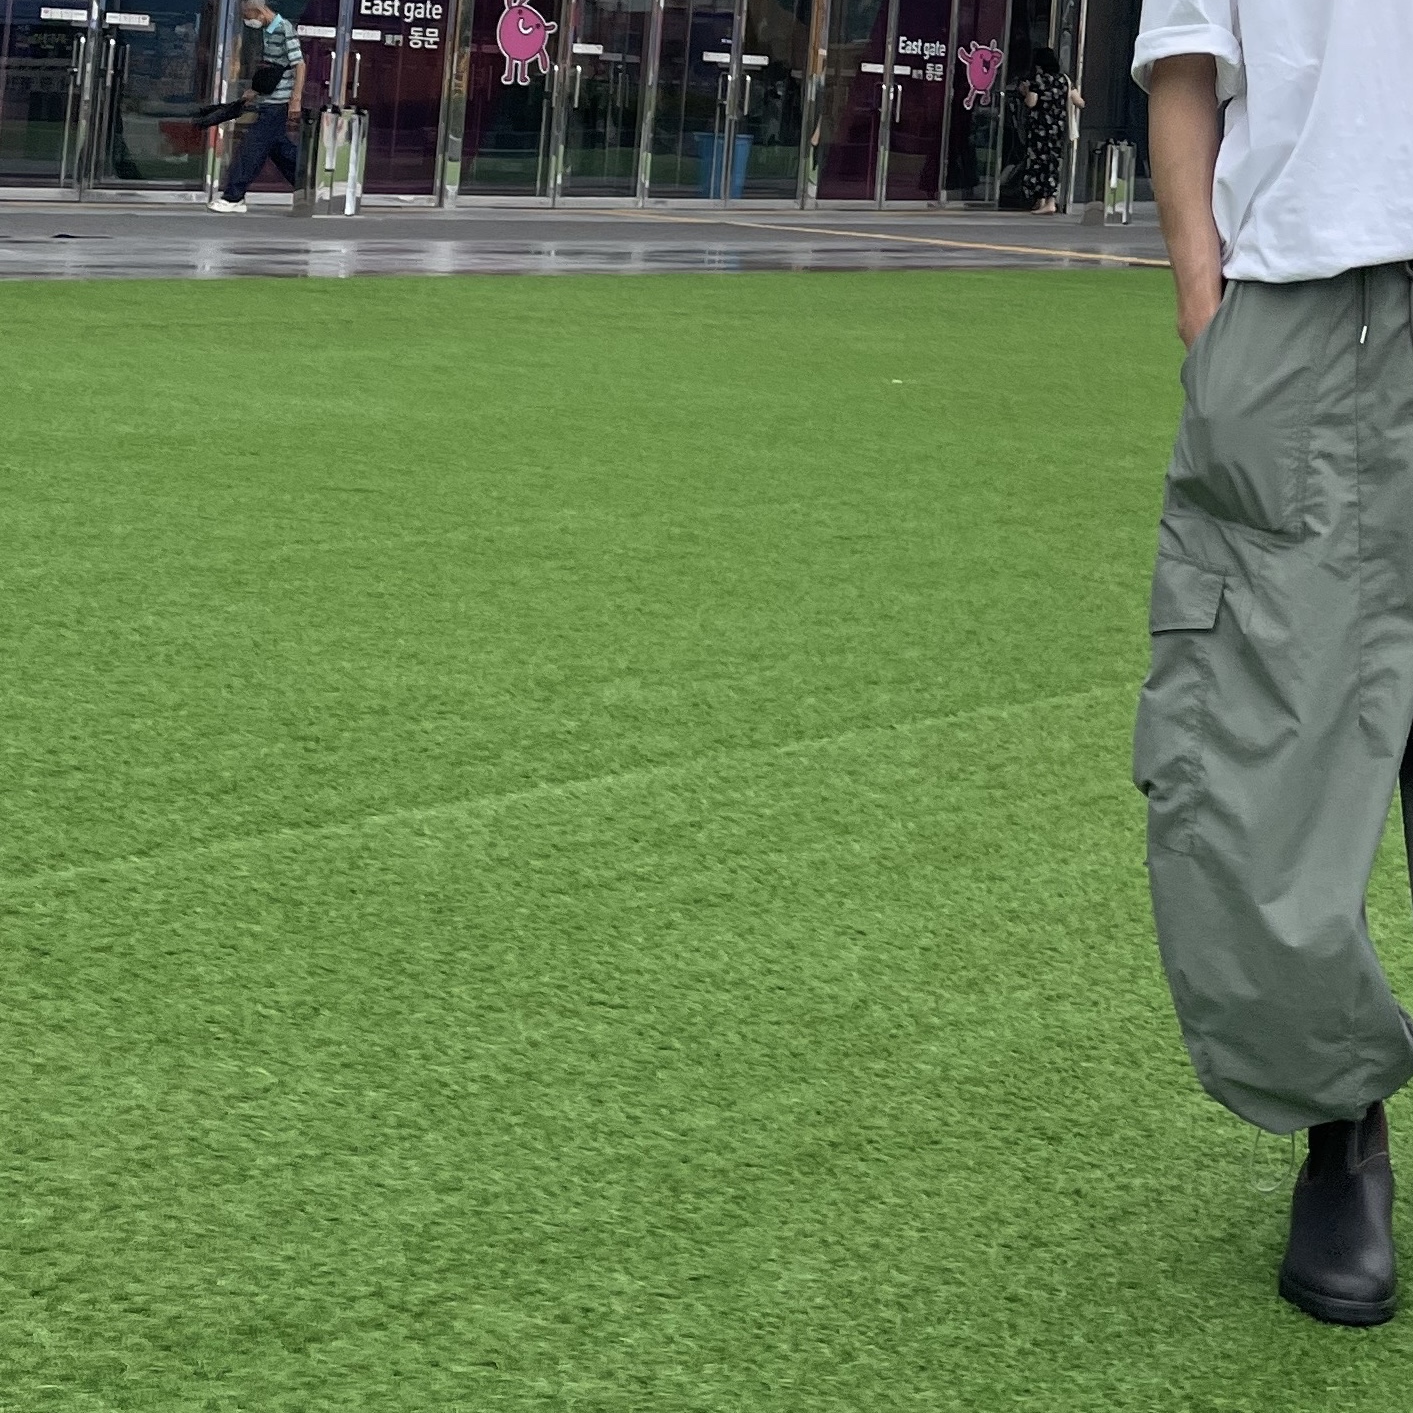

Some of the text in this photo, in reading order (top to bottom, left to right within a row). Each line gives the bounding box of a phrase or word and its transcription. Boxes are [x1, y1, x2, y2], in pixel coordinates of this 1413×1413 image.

[404, 0, 443, 23] gate
[408, 26, 439, 49] 동문
[899, 36, 946, 60] East gate
[925, 63, 944, 81] 동문
